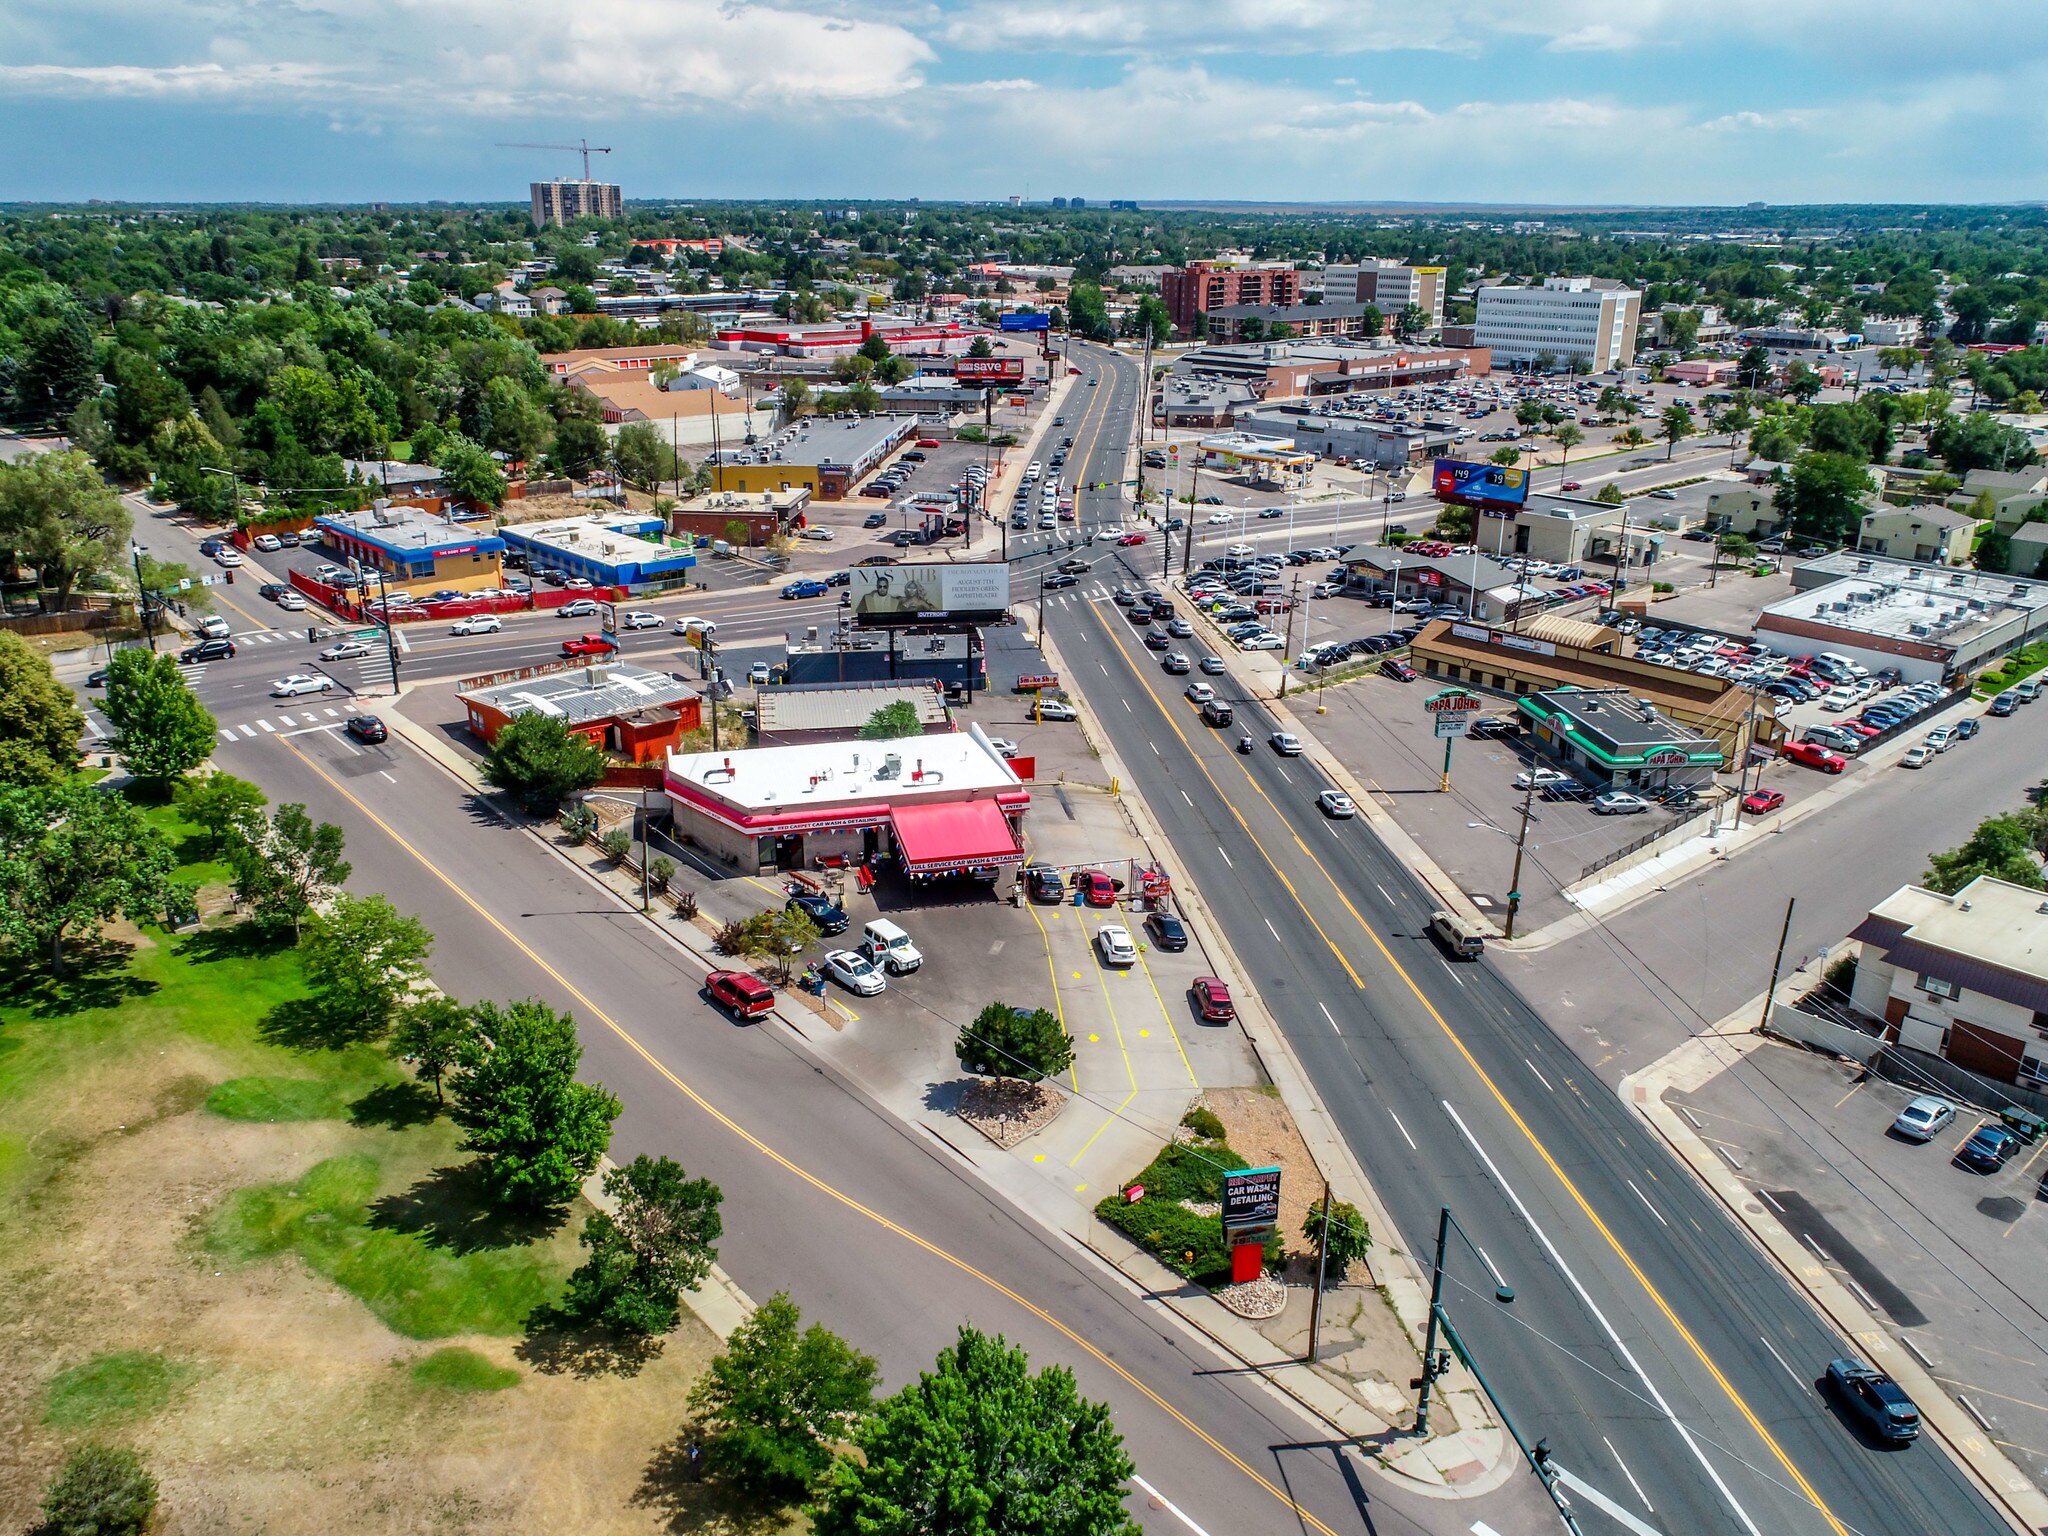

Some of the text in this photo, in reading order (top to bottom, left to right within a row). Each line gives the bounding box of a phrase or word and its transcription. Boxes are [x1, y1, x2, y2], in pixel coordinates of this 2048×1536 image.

[974, 362, 1002, 371] save
[1454, 469, 1469, 479] 149
[1493, 474, 1504, 484] 79
[859, 568, 894, 583] NAS
[1020, 676, 1040, 684] Smoke
[1430, 697, 1479, 710] PAPA JOHNS
[1650, 754, 1686, 764] PAPA JOHNS
[991, 854, 1024, 862] DETAILING
[1228, 1173, 1278, 1186] RED CARPET
[1228, 1186, 1245, 1196] CAR
[1246, 1184, 1270, 1194] WASH
[1230, 1194, 1273, 1205] DETAILING
